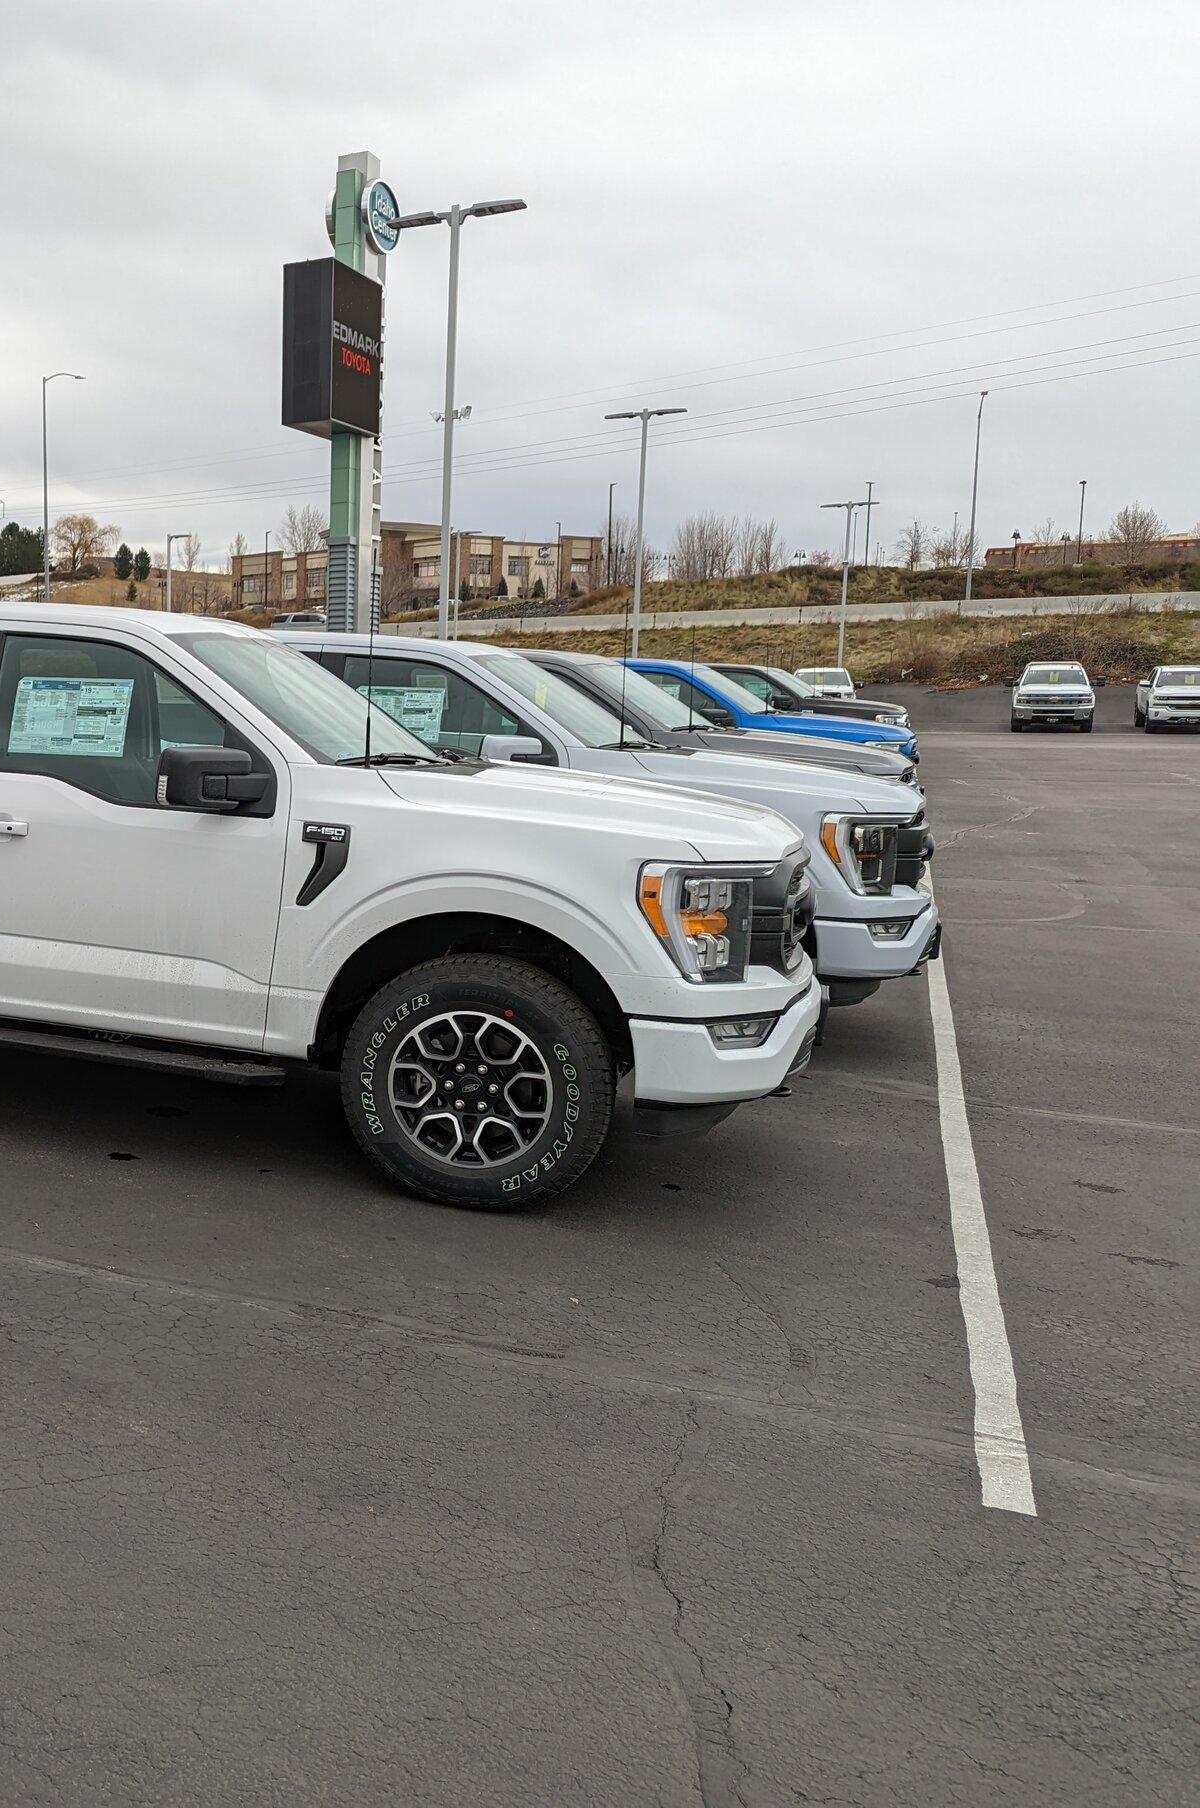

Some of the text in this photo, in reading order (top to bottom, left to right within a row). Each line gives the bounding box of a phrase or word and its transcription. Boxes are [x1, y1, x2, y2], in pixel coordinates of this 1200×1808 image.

[375, 190, 396, 220] Idaho
[372, 210, 397, 241] Center
[332, 320, 379, 358] EDMARK
[341, 347, 372, 376] TOYOTA
[306, 825, 345, 836] F-150
[360, 993, 431, 1135] WRANGLER
[501, 1042, 582, 1193] GOODYEAR
